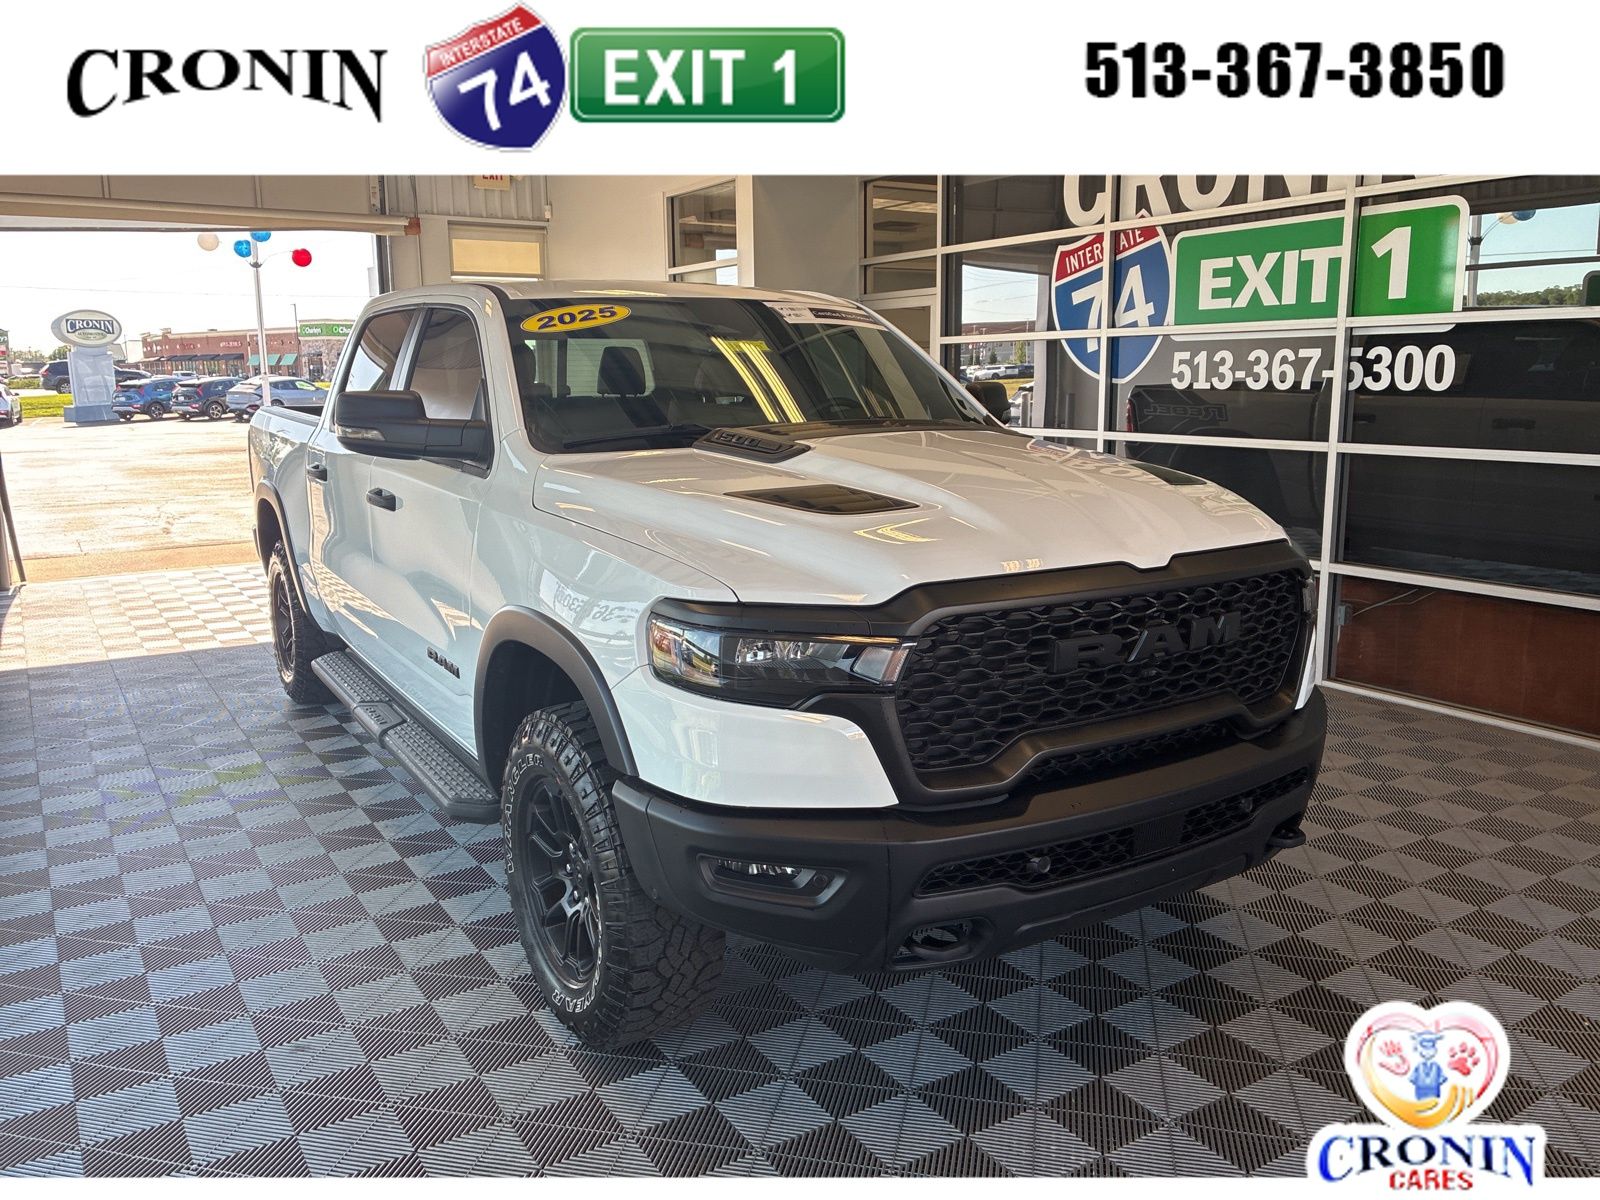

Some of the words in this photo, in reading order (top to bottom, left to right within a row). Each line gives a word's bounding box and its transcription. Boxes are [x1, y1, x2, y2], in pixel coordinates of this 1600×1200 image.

[1066, 229, 1144, 273] INTERATE
[1199, 246, 1344, 310] EXIT
[1371, 226, 1412, 300] 1
[67, 319, 113, 334] CRONIN
[537, 306, 617, 330] 2025
[1071, 265, 1155, 353] 74
[1170, 344, 1456, 391] 513-367-5300
[427, 646, 460, 679] RAM
[1052, 611, 1242, 673] RAM
